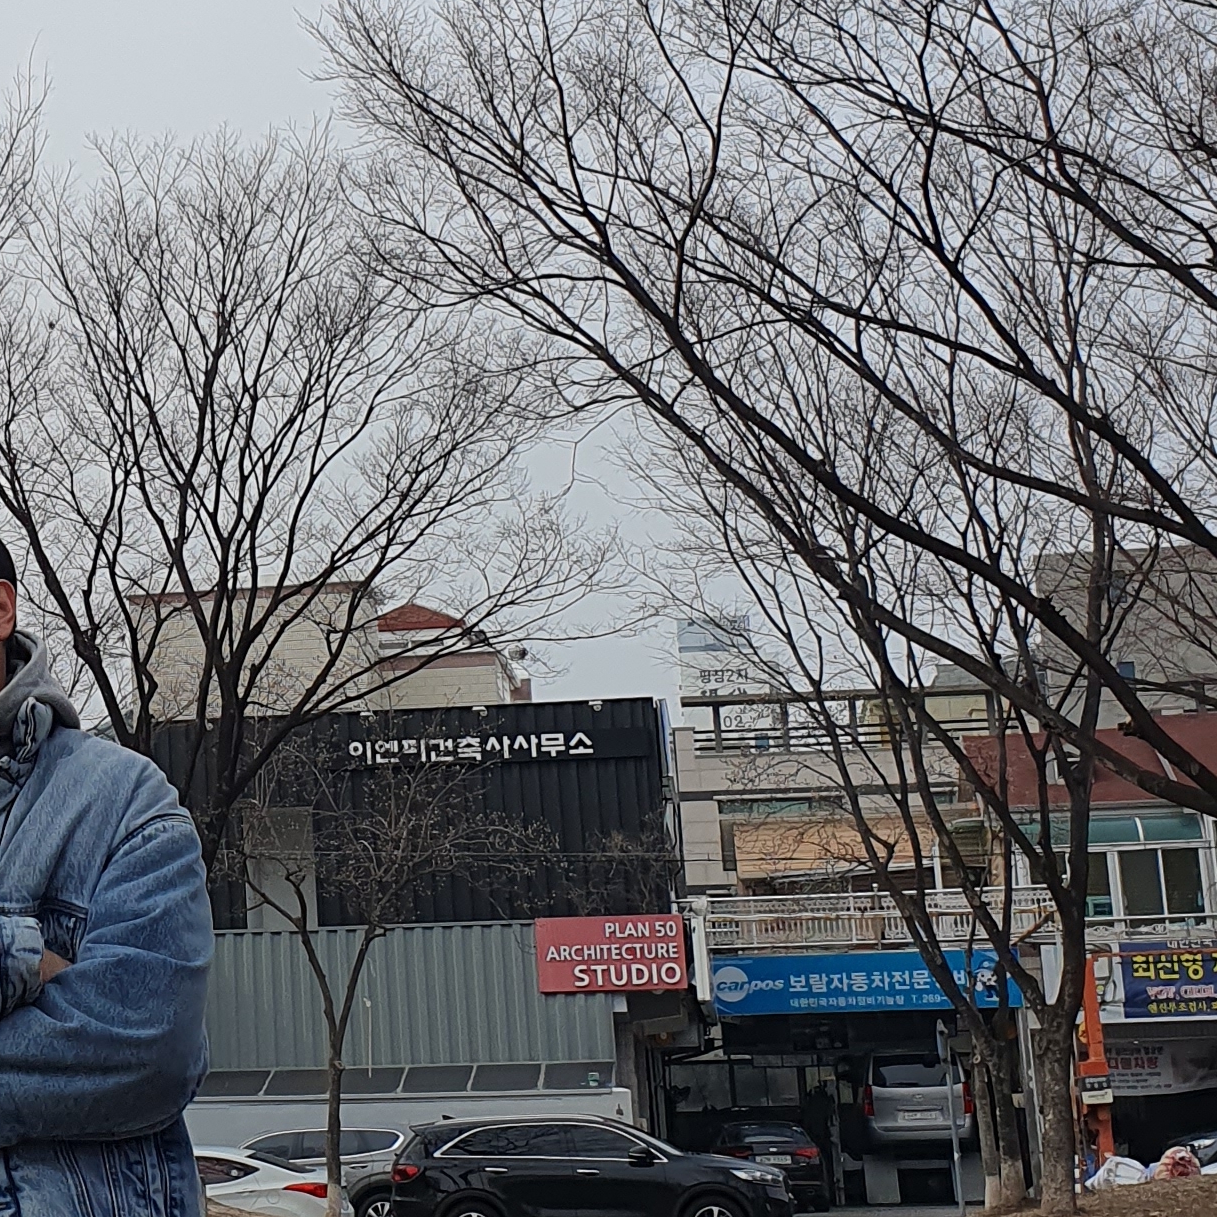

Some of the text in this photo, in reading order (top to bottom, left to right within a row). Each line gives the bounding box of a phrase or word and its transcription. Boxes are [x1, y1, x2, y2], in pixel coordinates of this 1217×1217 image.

[604, 921, 677, 938] PLAN 50
[545, 942, 680, 962] ARCHITECTURE
[573, 961, 682, 987] STUDIO
[1132, 953, 1204, 980] 최신형
[715, 979, 785, 994] carpos
[788, 969, 970, 993] 보람자동차전문비
